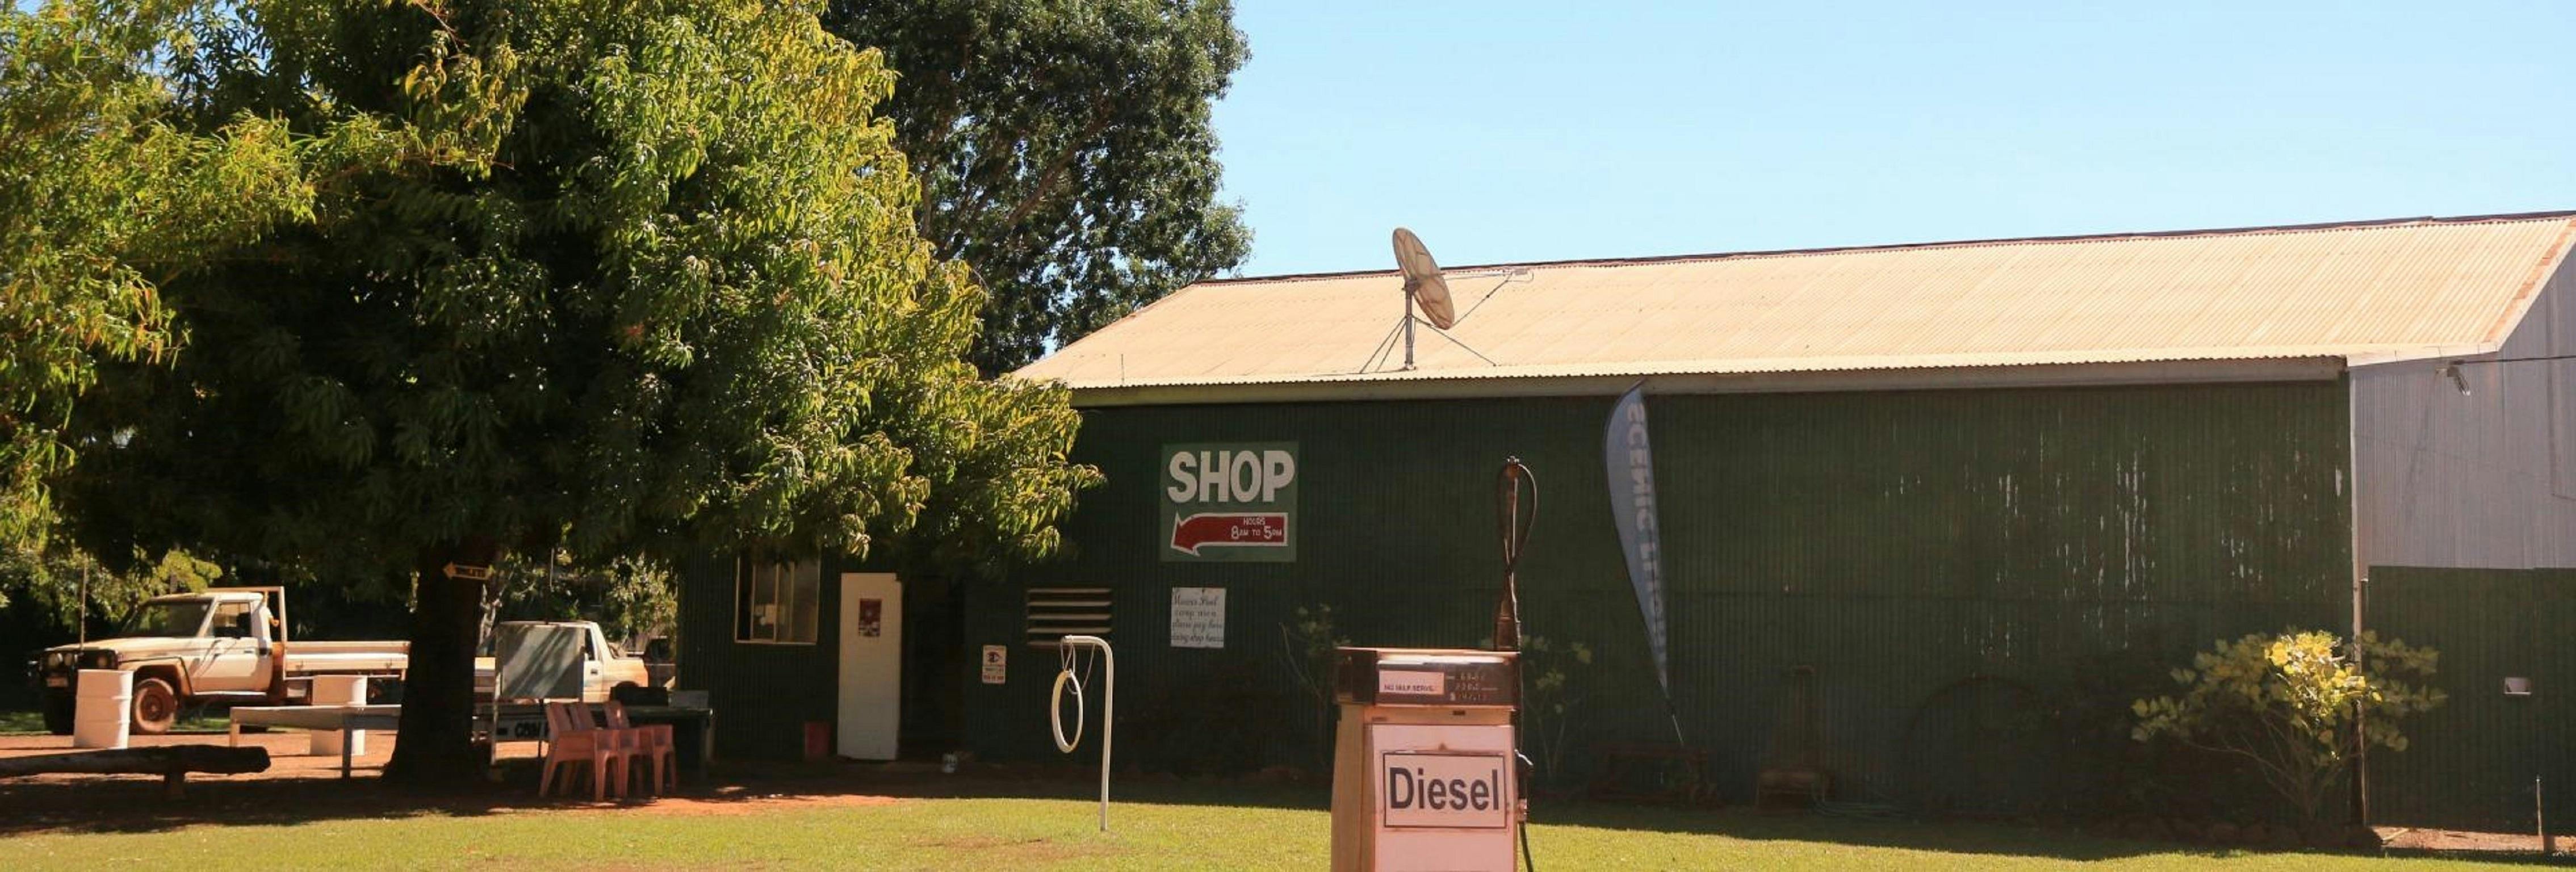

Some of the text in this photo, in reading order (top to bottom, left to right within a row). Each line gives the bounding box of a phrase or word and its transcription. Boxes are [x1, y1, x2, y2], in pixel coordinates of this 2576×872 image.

[1167, 450, 1295, 503] SHOP
[1231, 525, 1249, 539] 8AM
[1263, 525, 1282, 539] 5PM
[1389, 767, 1499, 811] Diesel
